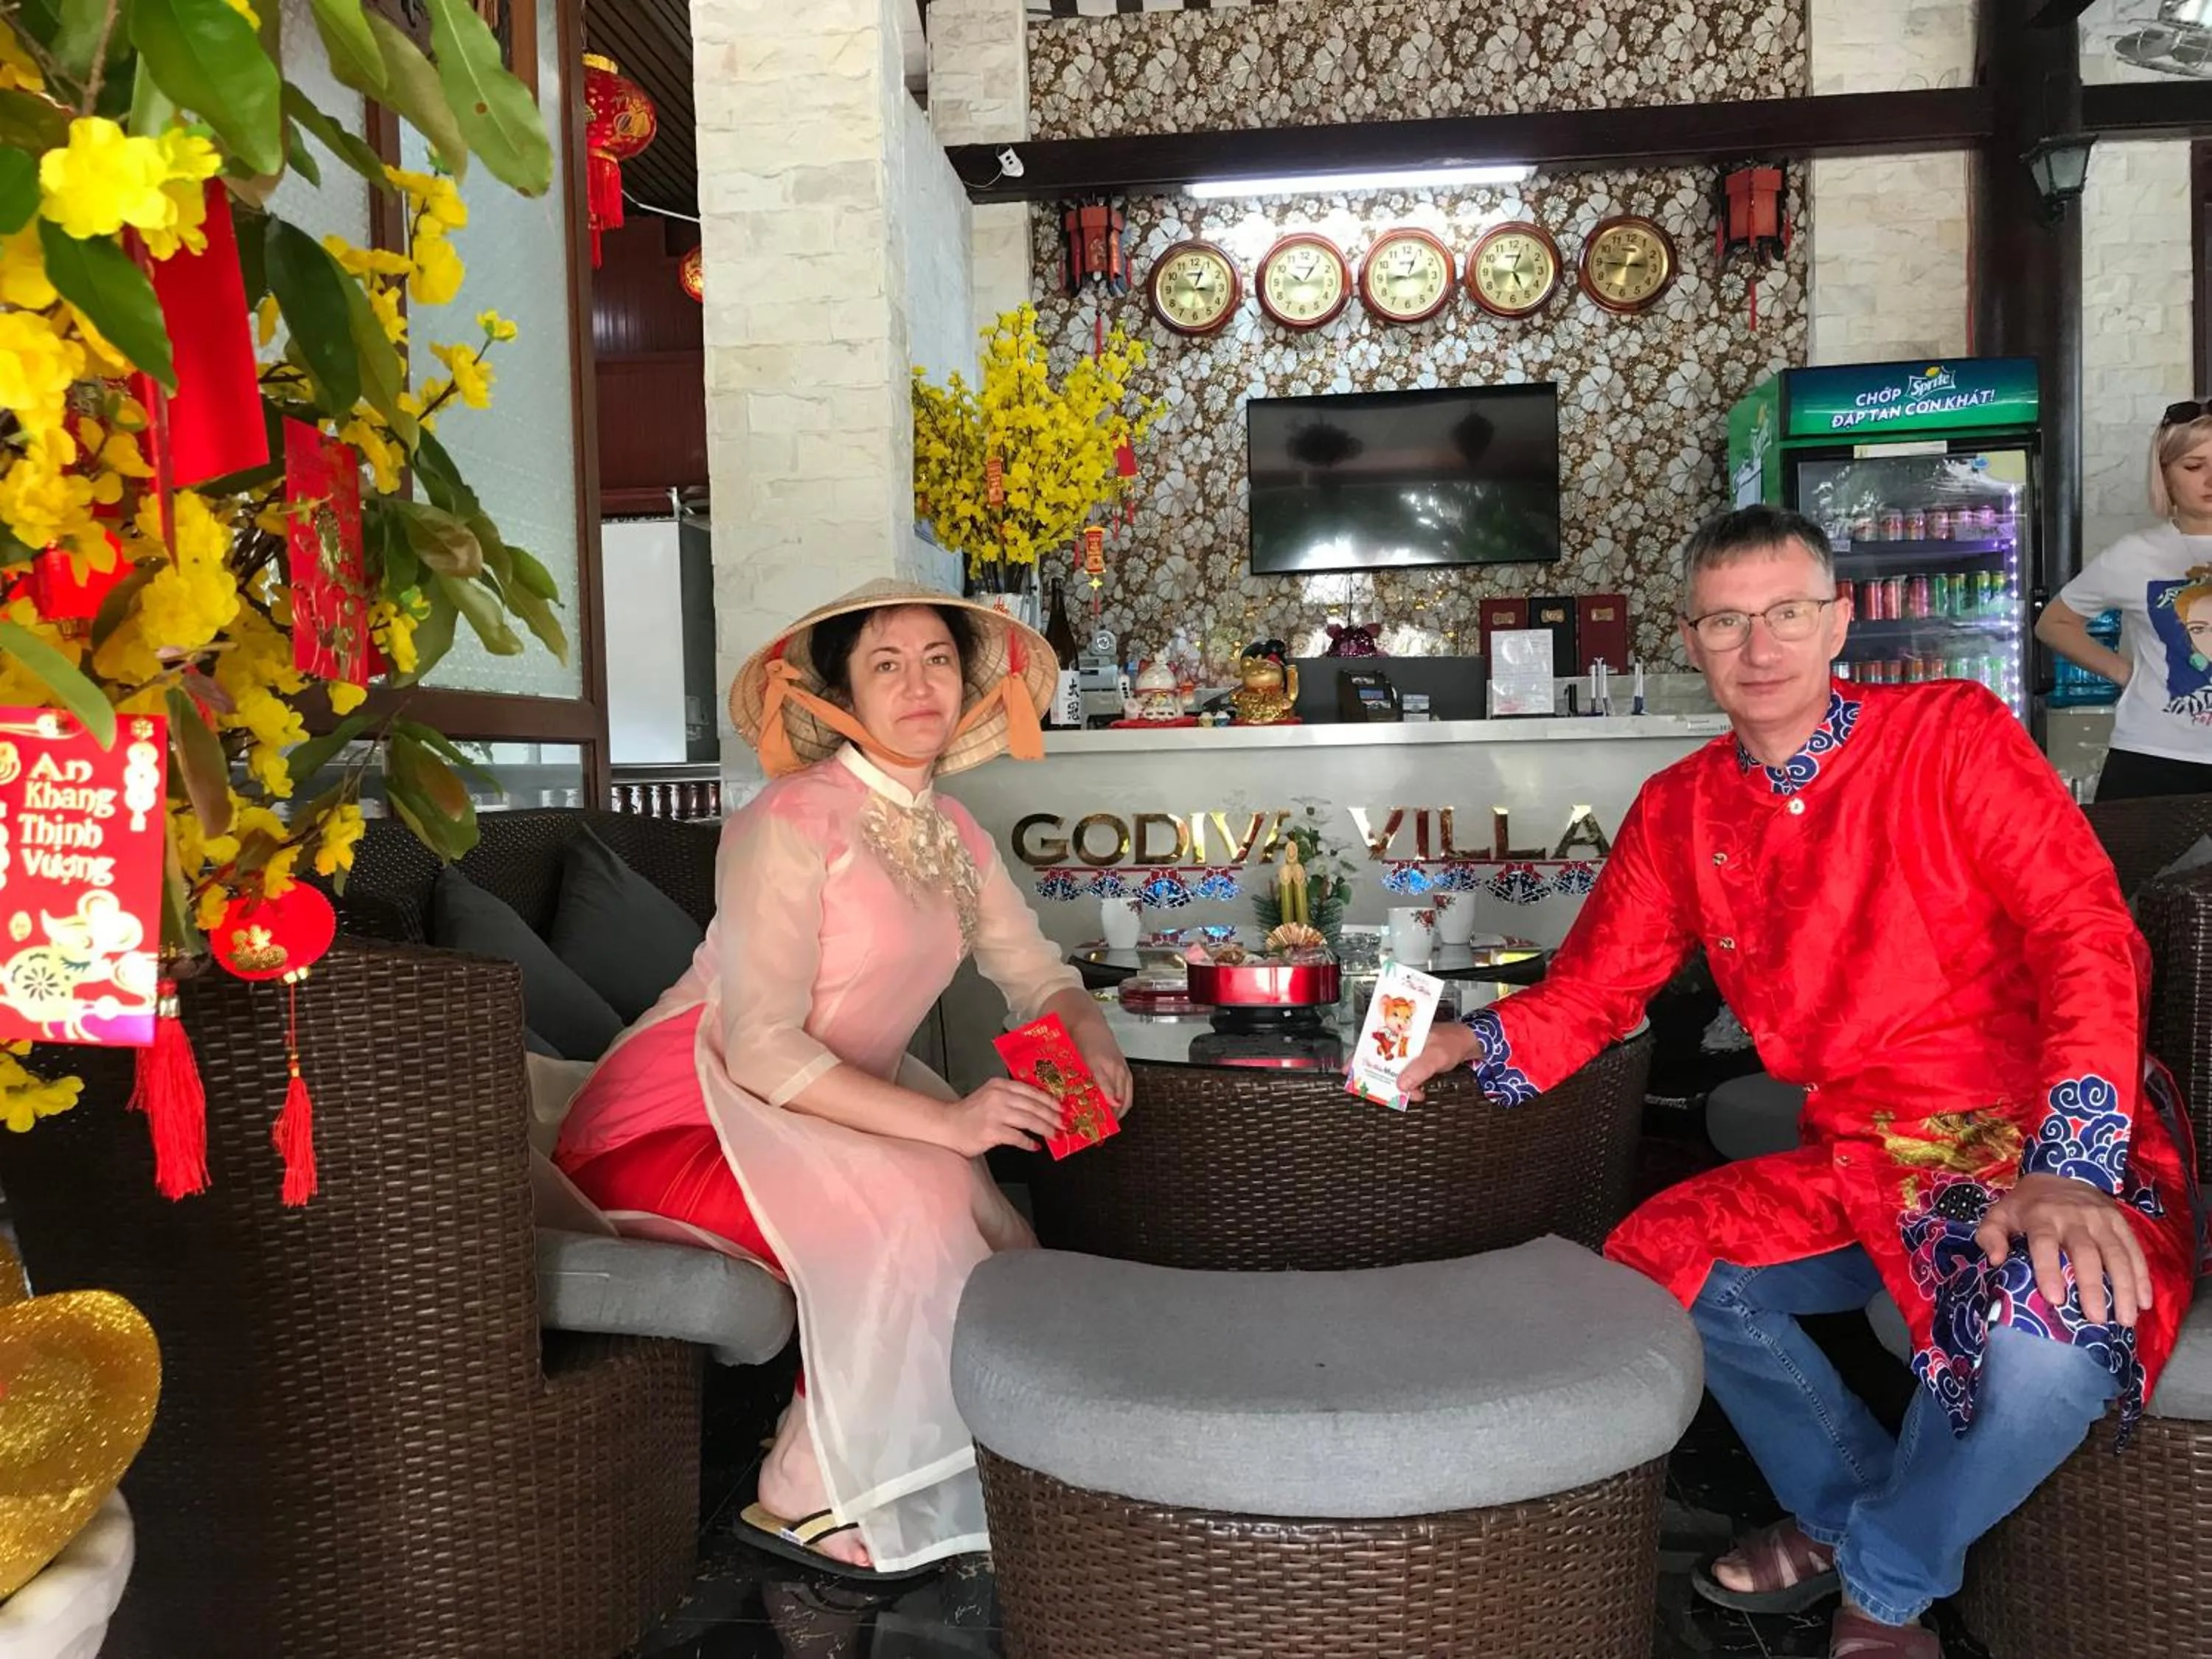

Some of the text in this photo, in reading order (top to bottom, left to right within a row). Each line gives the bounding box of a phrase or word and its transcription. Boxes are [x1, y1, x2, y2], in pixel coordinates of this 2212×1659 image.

[1612, 235, 1621, 244] 11
[1627, 234, 1637, 243] 12
[1495, 244, 1503, 253] 11
[1509, 240, 1519, 248] 12
[1402, 246, 1412, 254] 12
[1601, 245, 1611, 254] 10
[1287, 255, 1295, 263] 11
[1300, 251, 1310, 260] 12
[1388, 251, 1397, 259] 11
[1485, 254, 1495, 263] 10
[1534, 252, 1541, 262] 2
[1649, 250, 1656, 259] 2
[1178, 262, 1186, 270] 11
[1190, 258, 1200, 266] 12
[1379, 260, 1389, 269] 10
[1427, 257, 1434, 266] 2
[1596, 257, 1603, 266] 9
[1277, 265, 1287, 274] 10
[1324, 265, 1331, 273] 2
[1482, 268, 1489, 276] 9
[1537, 266, 1544, 276] 3
[1651, 265, 1658, 274] 3
[1168, 271, 1178, 280] 10
[1215, 271, 1220, 279] 2
[1377, 274, 1383, 283] 9
[1431, 271, 1438, 279] 3
[1598, 271, 1604, 281] 8
[1273, 278, 1279, 287] 9
[1327, 278, 1333, 288] 3
[1486, 281, 1493, 291] 8
[1533, 280, 1540, 289] 4
[1645, 277, 1651, 286] 4
[1165, 285, 1172, 294] 9
[1218, 283, 1225, 293] 3
[1427, 284, 1434, 293] 4
[1605, 282, 1613, 291] 7
[1634, 285, 1641, 295] 5
[1276, 291, 1284, 300] 8
[1323, 291, 1329, 299] 4
[1381, 288, 1387, 296] 8
[1495, 291, 1501, 299] 7
[1524, 290, 1531, 299] 5
[1618, 288, 1626, 297] 6
[1214, 297, 1220, 305] 4
[1390, 296, 1397, 305] 7
[1419, 295, 1426, 304] 5
[1509, 294, 1517, 303] 6
[1169, 299, 1176, 308] 8
[1285, 301, 1292, 310] 7
[1313, 301, 1320, 310] 5
[1405, 299, 1411, 309] 6
[1179, 308, 1185, 317] 7
[1206, 307, 1212, 316] 5
[1298, 305, 1305, 314] 6
[1192, 311, 1198, 321] 6
[1910, 372, 1950, 397] Sprite
[1868, 406, 1902, 422] TAN
[1942, 389, 1996, 409] KHÁT!
[27, 751, 94, 783] An
[24, 780, 118, 818] Khang
[17, 813, 104, 851] Thịnh
[1347, 804, 1612, 861] VILLA
